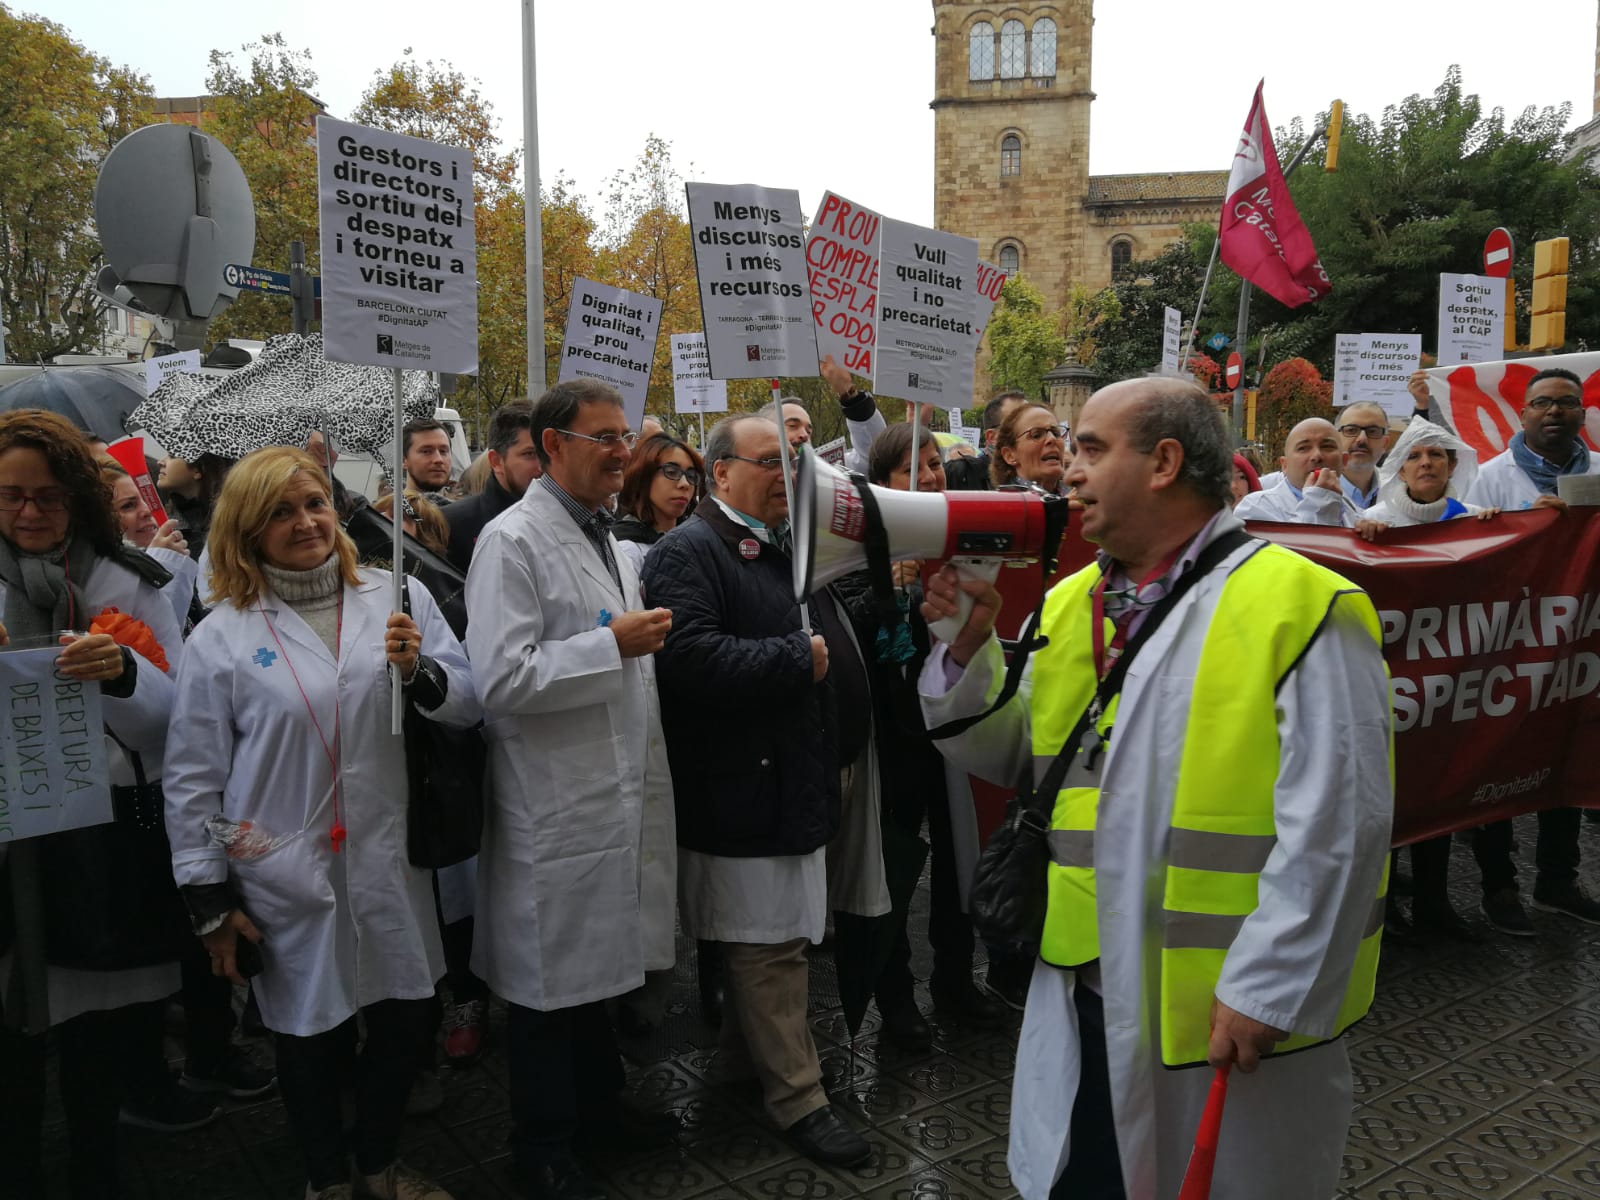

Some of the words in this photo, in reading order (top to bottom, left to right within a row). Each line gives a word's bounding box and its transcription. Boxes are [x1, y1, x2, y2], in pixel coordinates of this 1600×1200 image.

[337, 136, 443, 176] Gestors
[452, 161, 458, 180] i
[333, 161, 463, 208] directors,
[336, 189, 415, 218] sortiu
[424, 204, 462, 227] del
[713, 201, 781, 225] Menys
[819, 194, 878, 246] PROU
[347, 212, 453, 249] despatx
[698, 227, 801, 249] discursos
[336, 233, 343, 253] i
[353, 237, 440, 270] torneu
[450, 258, 464, 274] a
[726, 252, 732, 270] i
[741, 252, 782, 271] més
[914, 243, 946, 265] Vull
[360, 264, 445, 293] visitar
[896, 265, 962, 290] qualitat
[710, 281, 802, 297] recursos
[807, 266, 876, 318] ESPLA
[913, 287, 918, 302] i
[924, 292, 944, 307] no
[1456, 283, 1491, 295] Sortiu
[1465, 294, 1482, 304] del
[357, 299, 415, 315] BARCELONA
[417, 308, 447, 319] CIUTAT
[581, 293, 642, 320] Dignitat
[647, 311, 653, 323] i
[1447, 304, 1498, 318] despatx,
[378, 314, 428, 327] #DignitatAP
[582, 314, 645, 340] qualitat,
[882, 307, 971, 335] precarietat
[1452, 325, 1464, 334] al
[1469, 325, 1492, 336] CAP
[1453, 315, 1491, 326] torneu
[394, 340, 422, 351] Metges
[423, 343, 431, 351] de
[594, 334, 628, 351] prou
[895, 339, 944, 354] METROPOLITANA
[1371, 341, 1409, 351] Menys
[157, 359, 187, 369] Volem
[395, 349, 431, 360] Catalunya
[567, 346, 648, 373] precarietat
[844, 344, 872, 374] JA
[1360, 351, 1417, 361] discursos
[689, 362, 709, 370] prou
[1371, 362, 1375, 370] i
[1379, 362, 1403, 371] més
[1360, 374, 1411, 382] recursos
[10, 682, 41, 710] DE
[1390, 651, 1600, 732] SPECTAD
